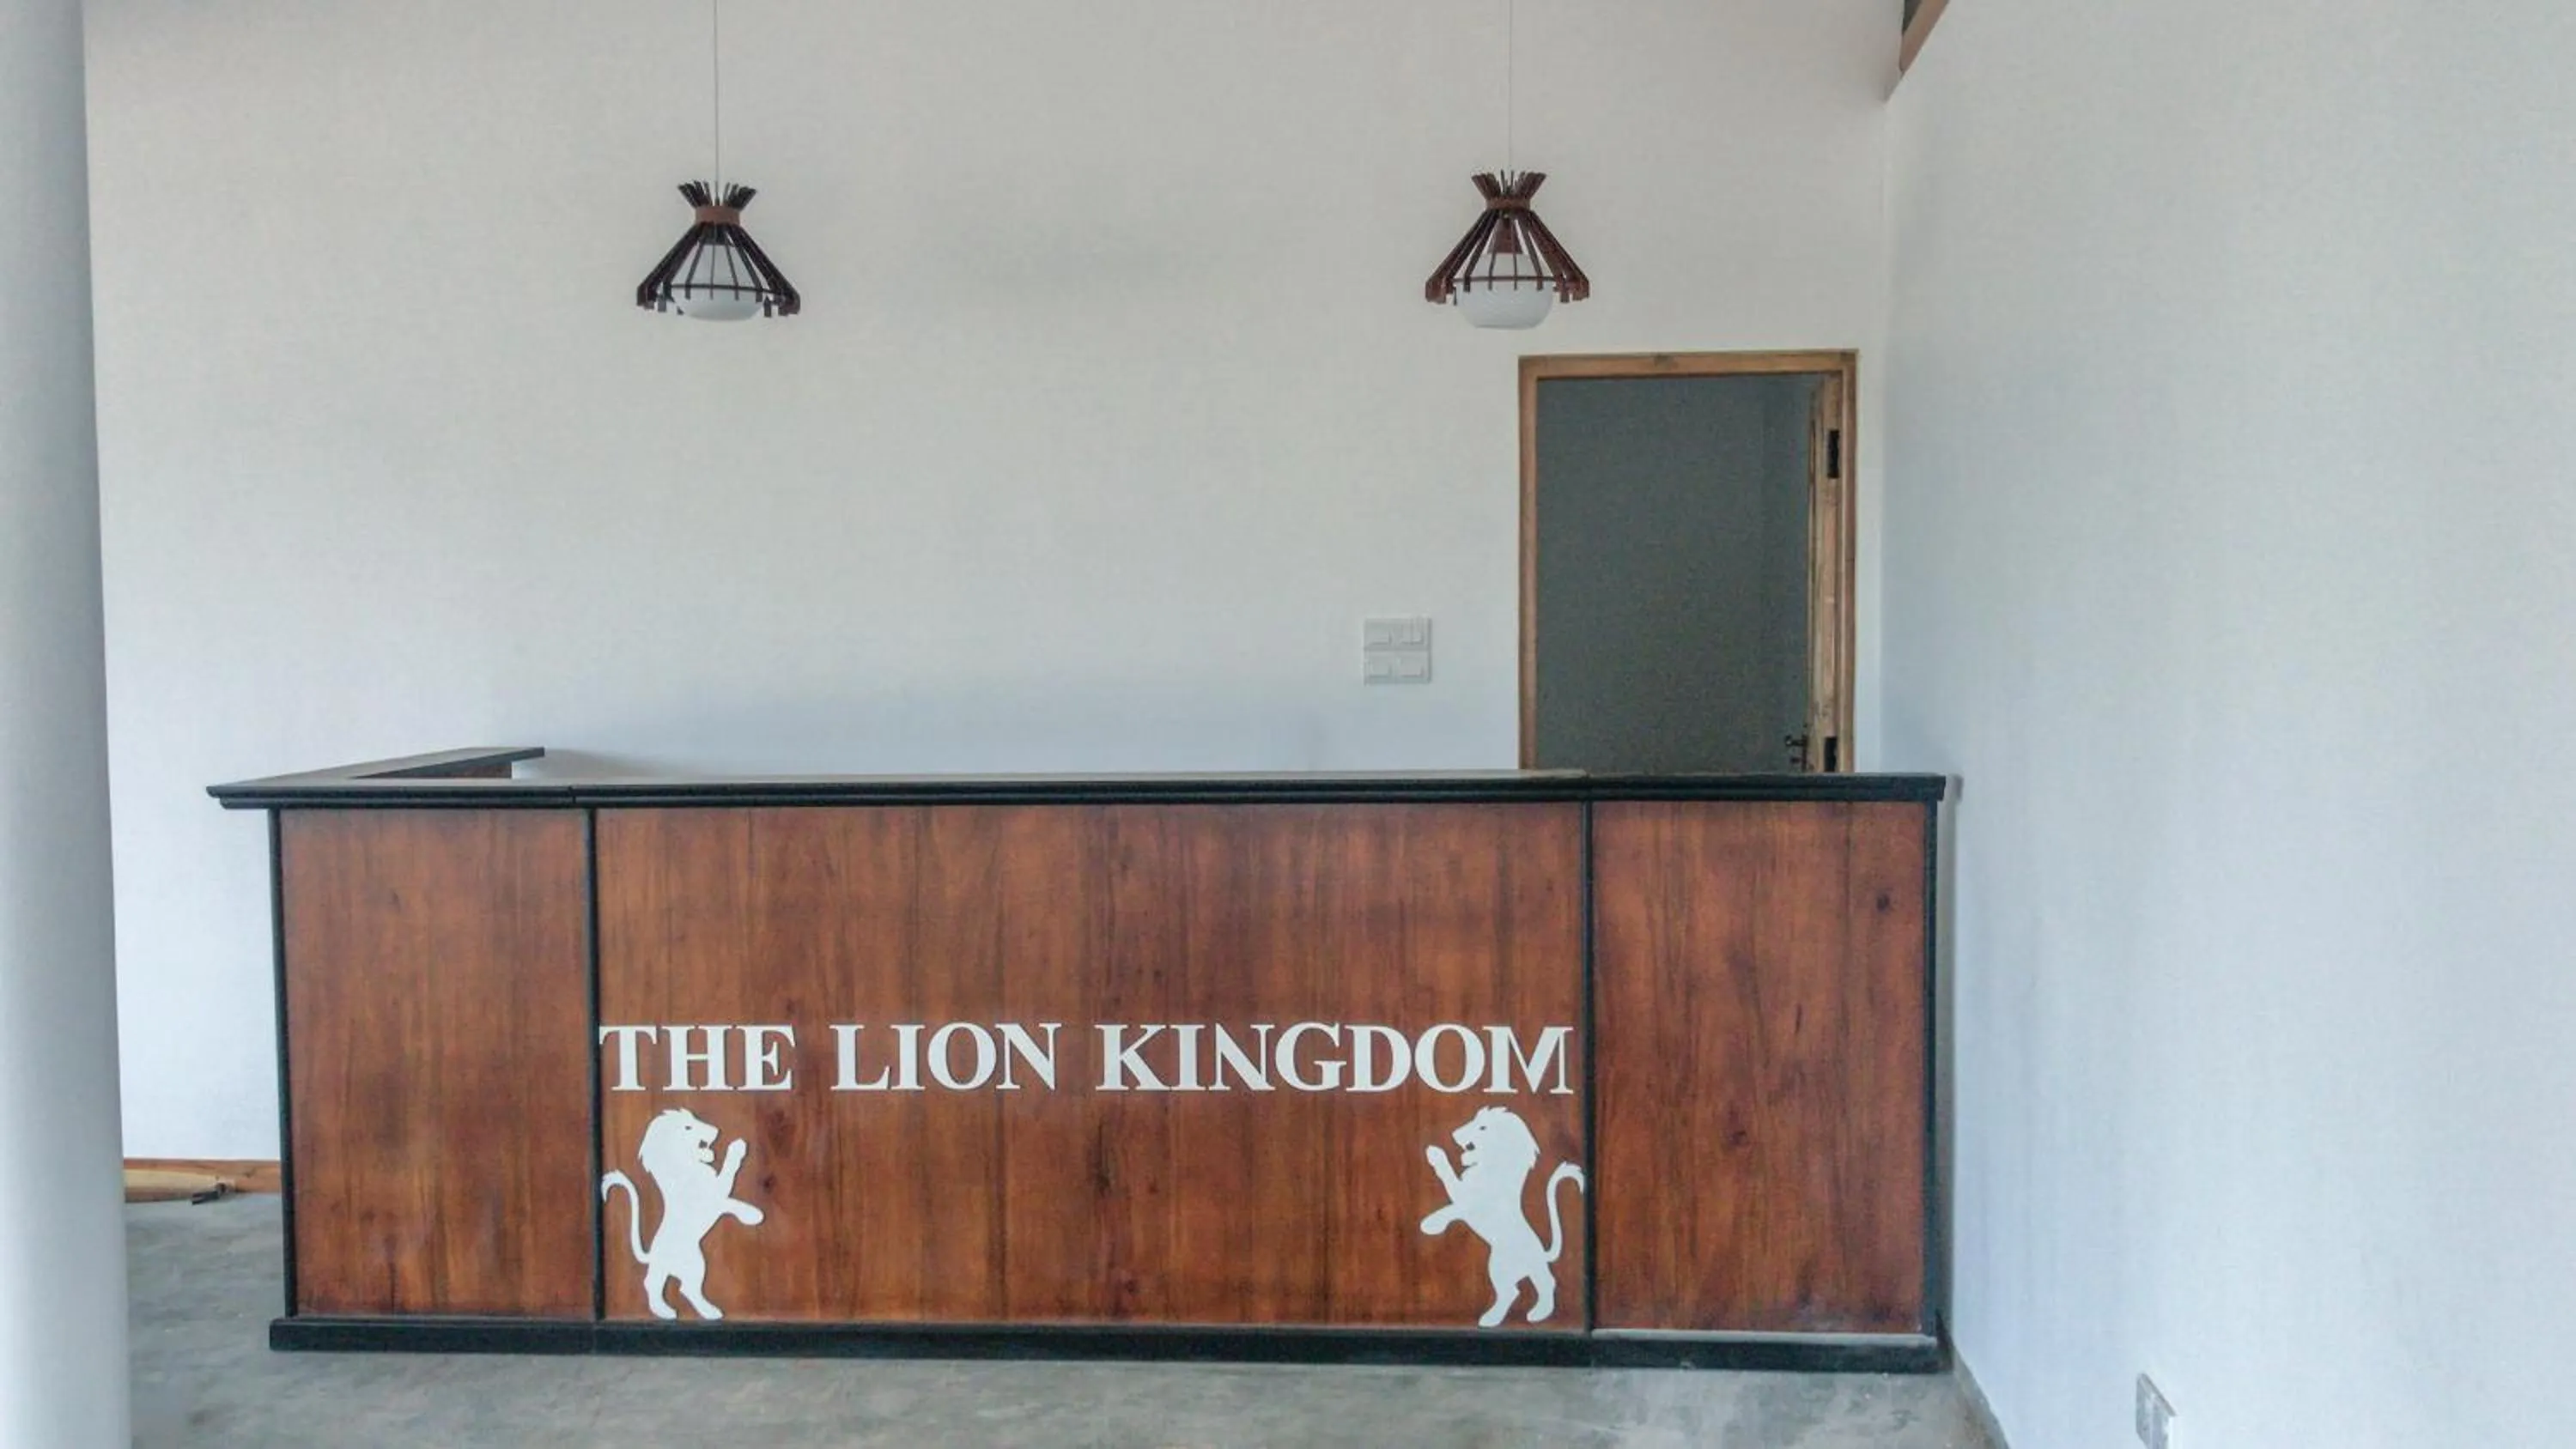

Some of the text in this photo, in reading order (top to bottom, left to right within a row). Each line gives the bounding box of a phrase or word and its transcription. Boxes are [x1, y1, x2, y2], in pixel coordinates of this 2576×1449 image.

[598, 1022, 1575, 1094] THE LION KINGDOM
